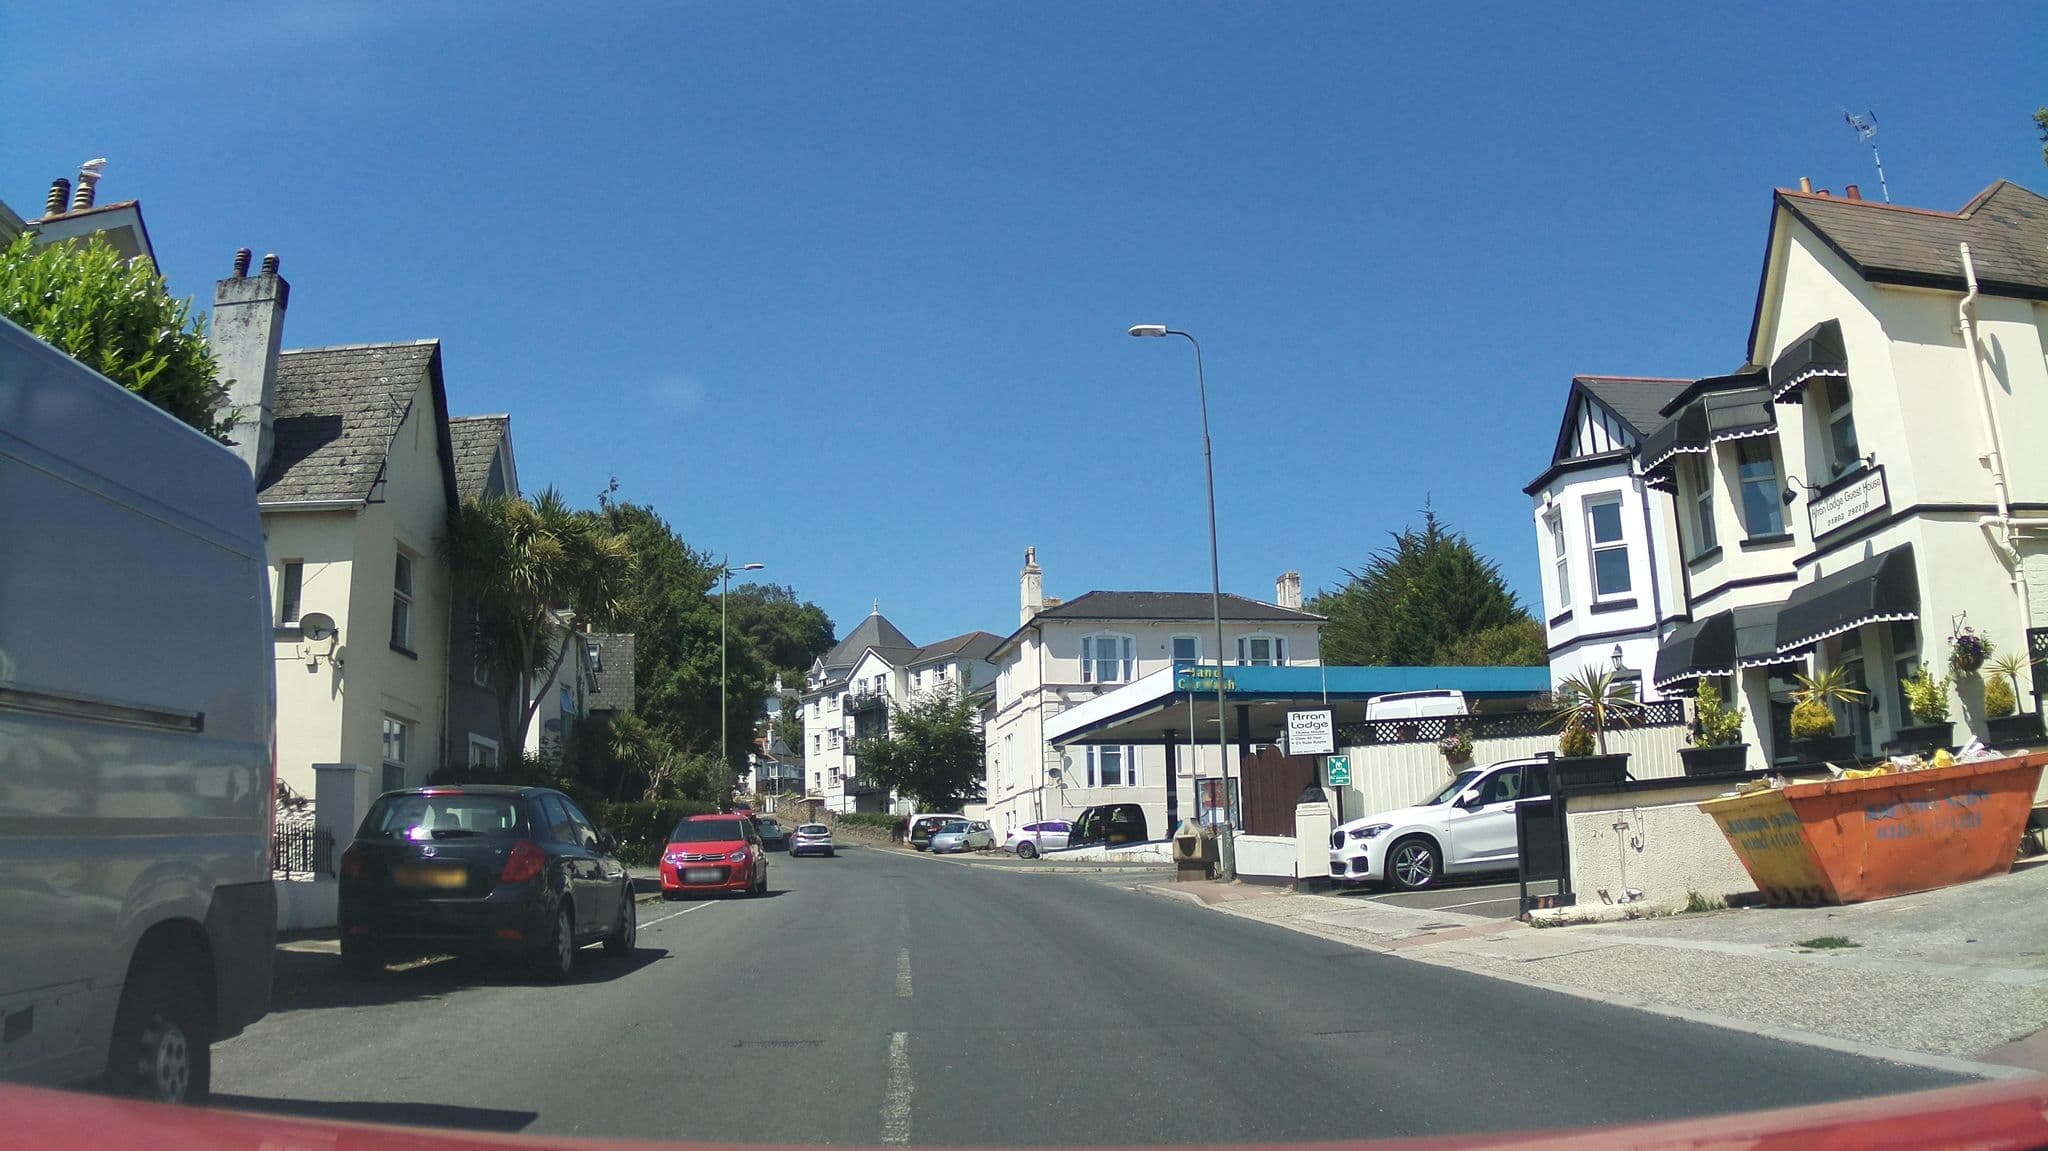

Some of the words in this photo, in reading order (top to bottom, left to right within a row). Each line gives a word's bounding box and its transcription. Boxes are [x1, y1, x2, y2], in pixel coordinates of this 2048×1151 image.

[1844, 488, 1862, 502] Guest
[1862, 479, 1881, 493] House
[1178, 678, 1200, 689] Cr
[1292, 713, 1325, 721] Arran
[1291, 721, 1329, 730] Lodge
